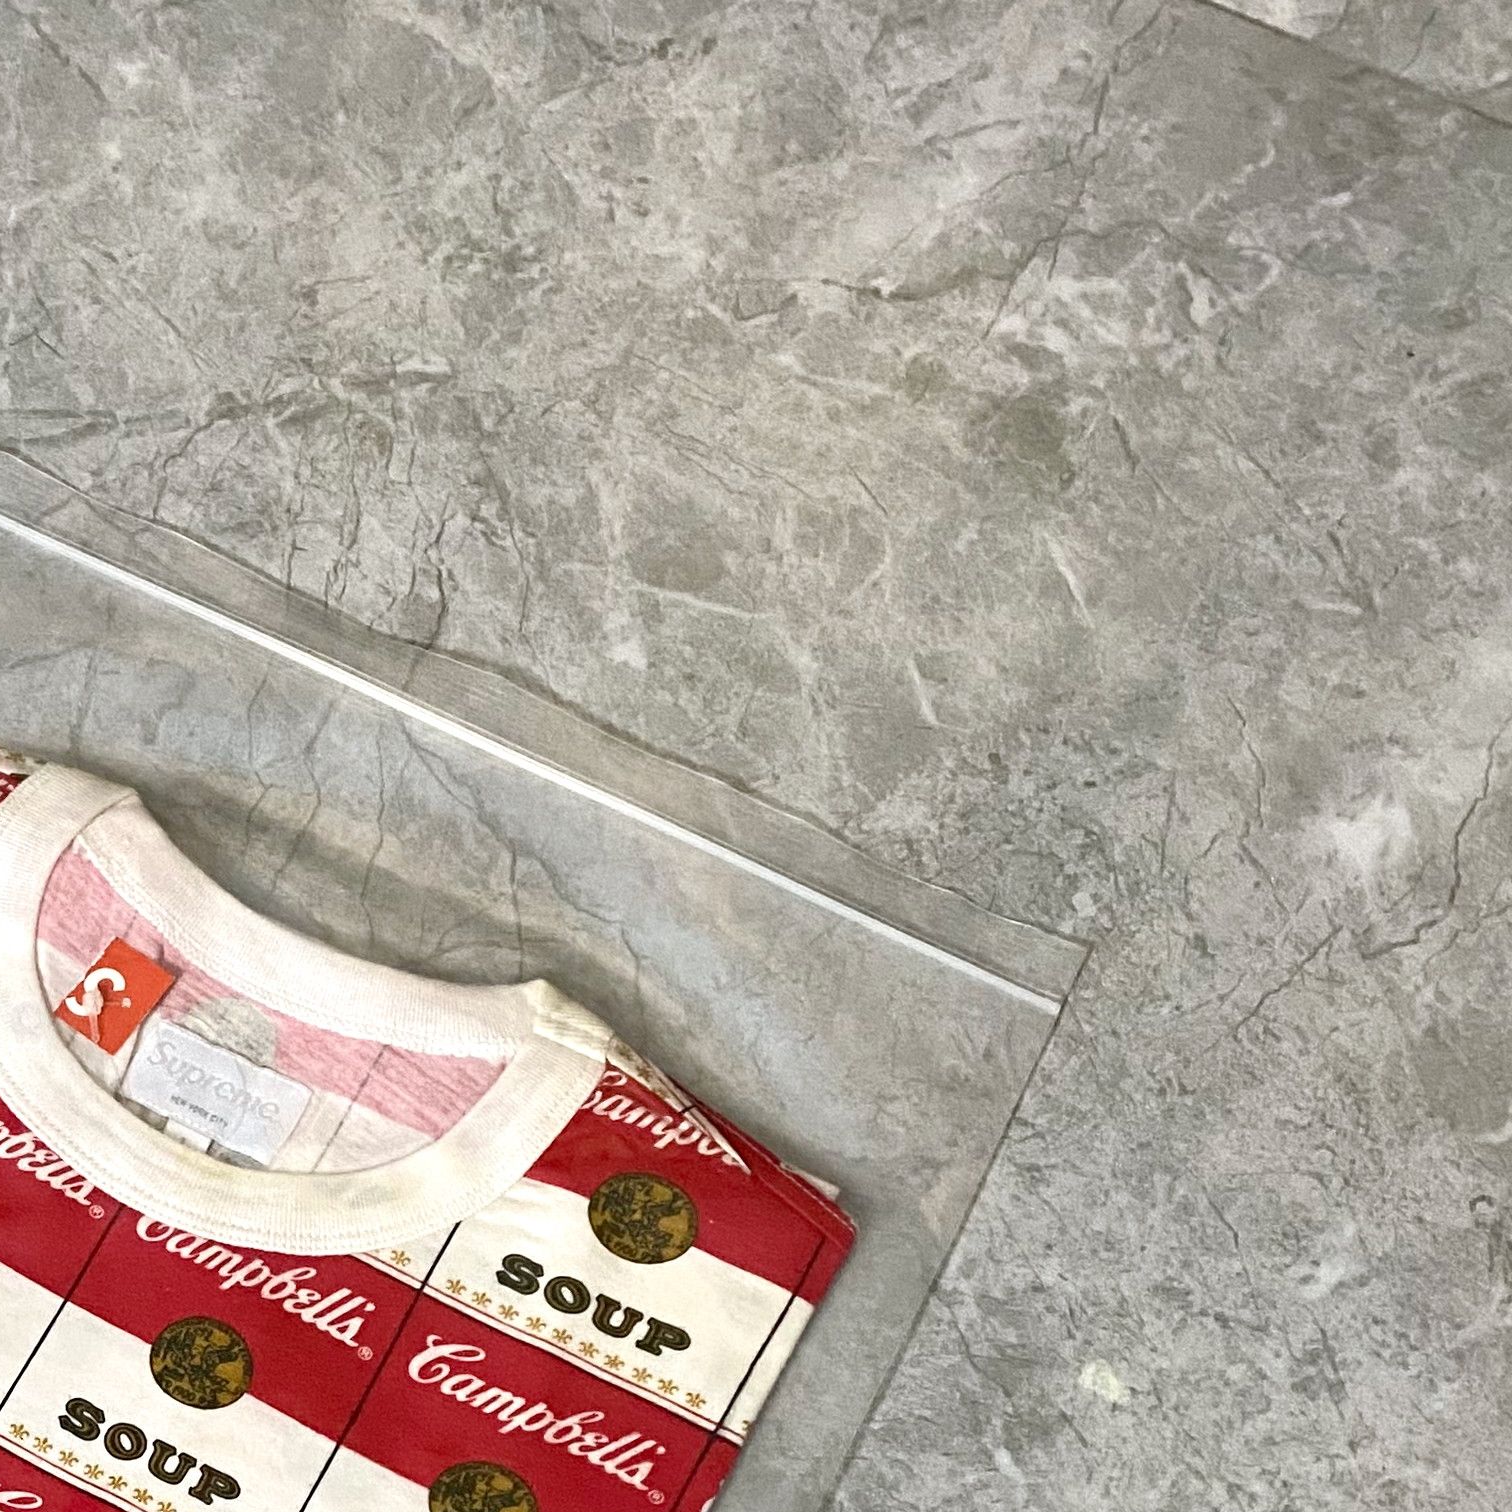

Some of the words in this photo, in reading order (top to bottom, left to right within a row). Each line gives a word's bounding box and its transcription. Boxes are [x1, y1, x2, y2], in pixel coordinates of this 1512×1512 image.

[496, 1254, 691, 1356] SOUP
[58, 1398, 241, 1505] SOUP
[409, 1335, 666, 1490] Campbell's
